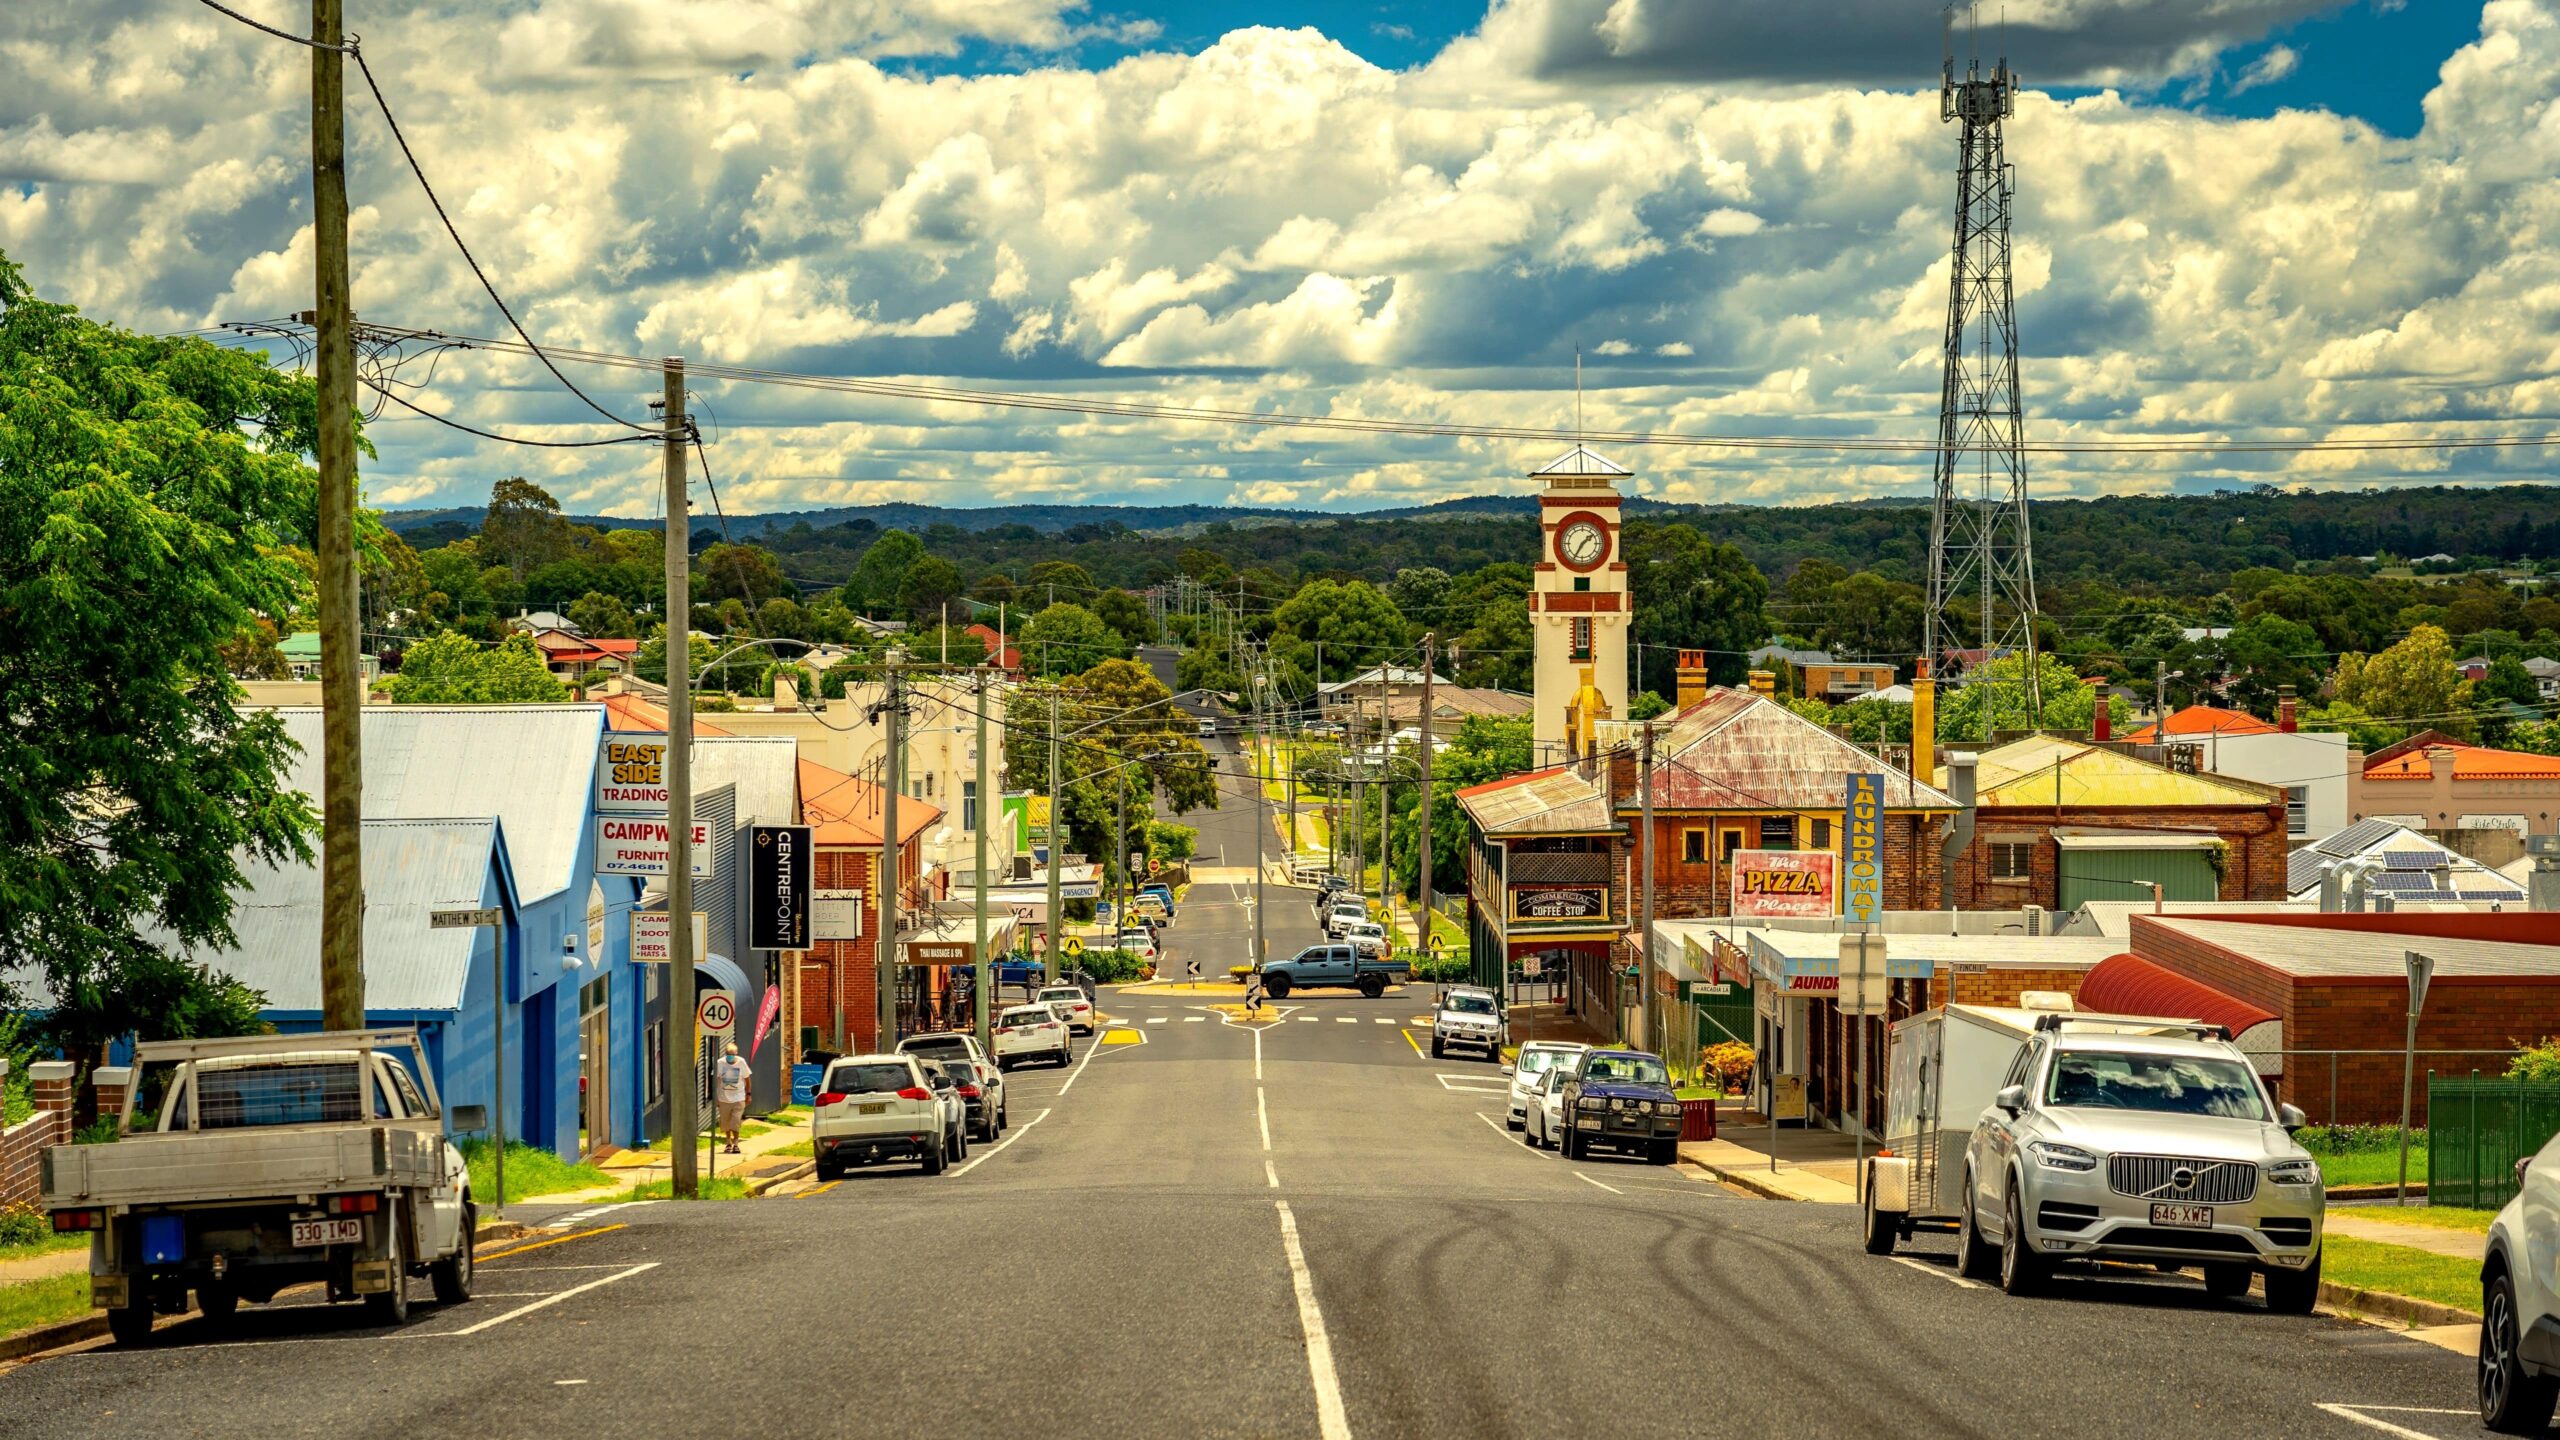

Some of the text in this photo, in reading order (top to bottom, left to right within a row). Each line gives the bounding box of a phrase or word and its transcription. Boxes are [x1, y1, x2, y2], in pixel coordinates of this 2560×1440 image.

[608, 743, 667, 765] EAST
[612, 764, 662, 785] SIDE
[602, 788, 668, 801] TRADING
[603, 821, 706, 844] CAMPWE
[1850, 777, 1878, 921] LAUNDROMAT
[1768, 856, 1800, 868] The
[777, 831, 791, 945] CENTREPOINT
[1742, 869, 1823, 895] PIZZA
[1062, 887, 1094, 897] EWSAGENCY
[1528, 892, 1590, 904] COMMERCIAL
[1532, 905, 1586, 916] COFFEE STOP
[1754, 899, 1813, 911] Place
[431, 911, 483, 926] MATTHEW ST
[930, 948, 950, 958] MASSAGE
[1789, 975, 1840, 990] AUNDR
[704, 1004, 730, 1021] 40
